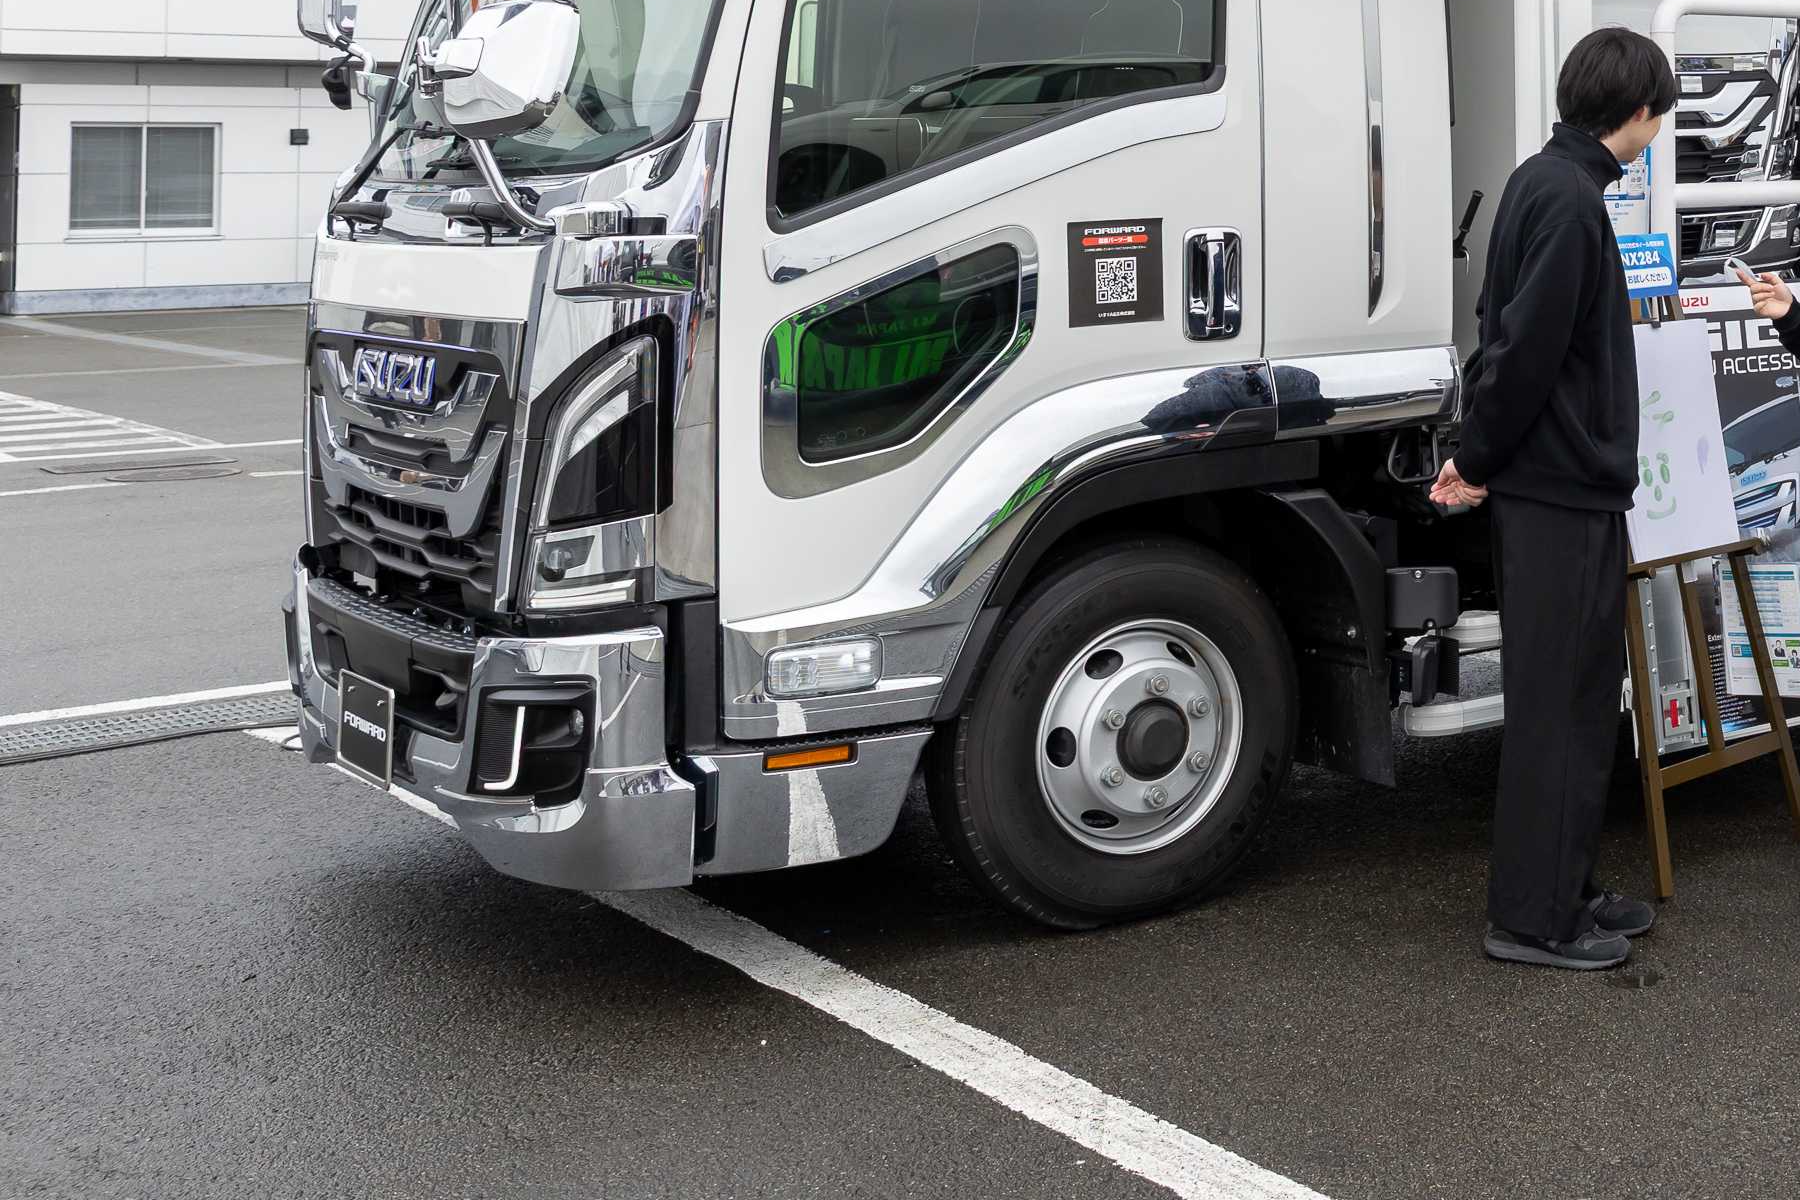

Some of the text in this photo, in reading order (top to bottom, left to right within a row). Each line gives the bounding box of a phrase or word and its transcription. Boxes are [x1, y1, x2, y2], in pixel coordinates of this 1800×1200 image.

[1084, 225, 1146, 236] FORWARD
[353, 347, 436, 406] ISUZU
[344, 710, 387, 742] FORWARD
